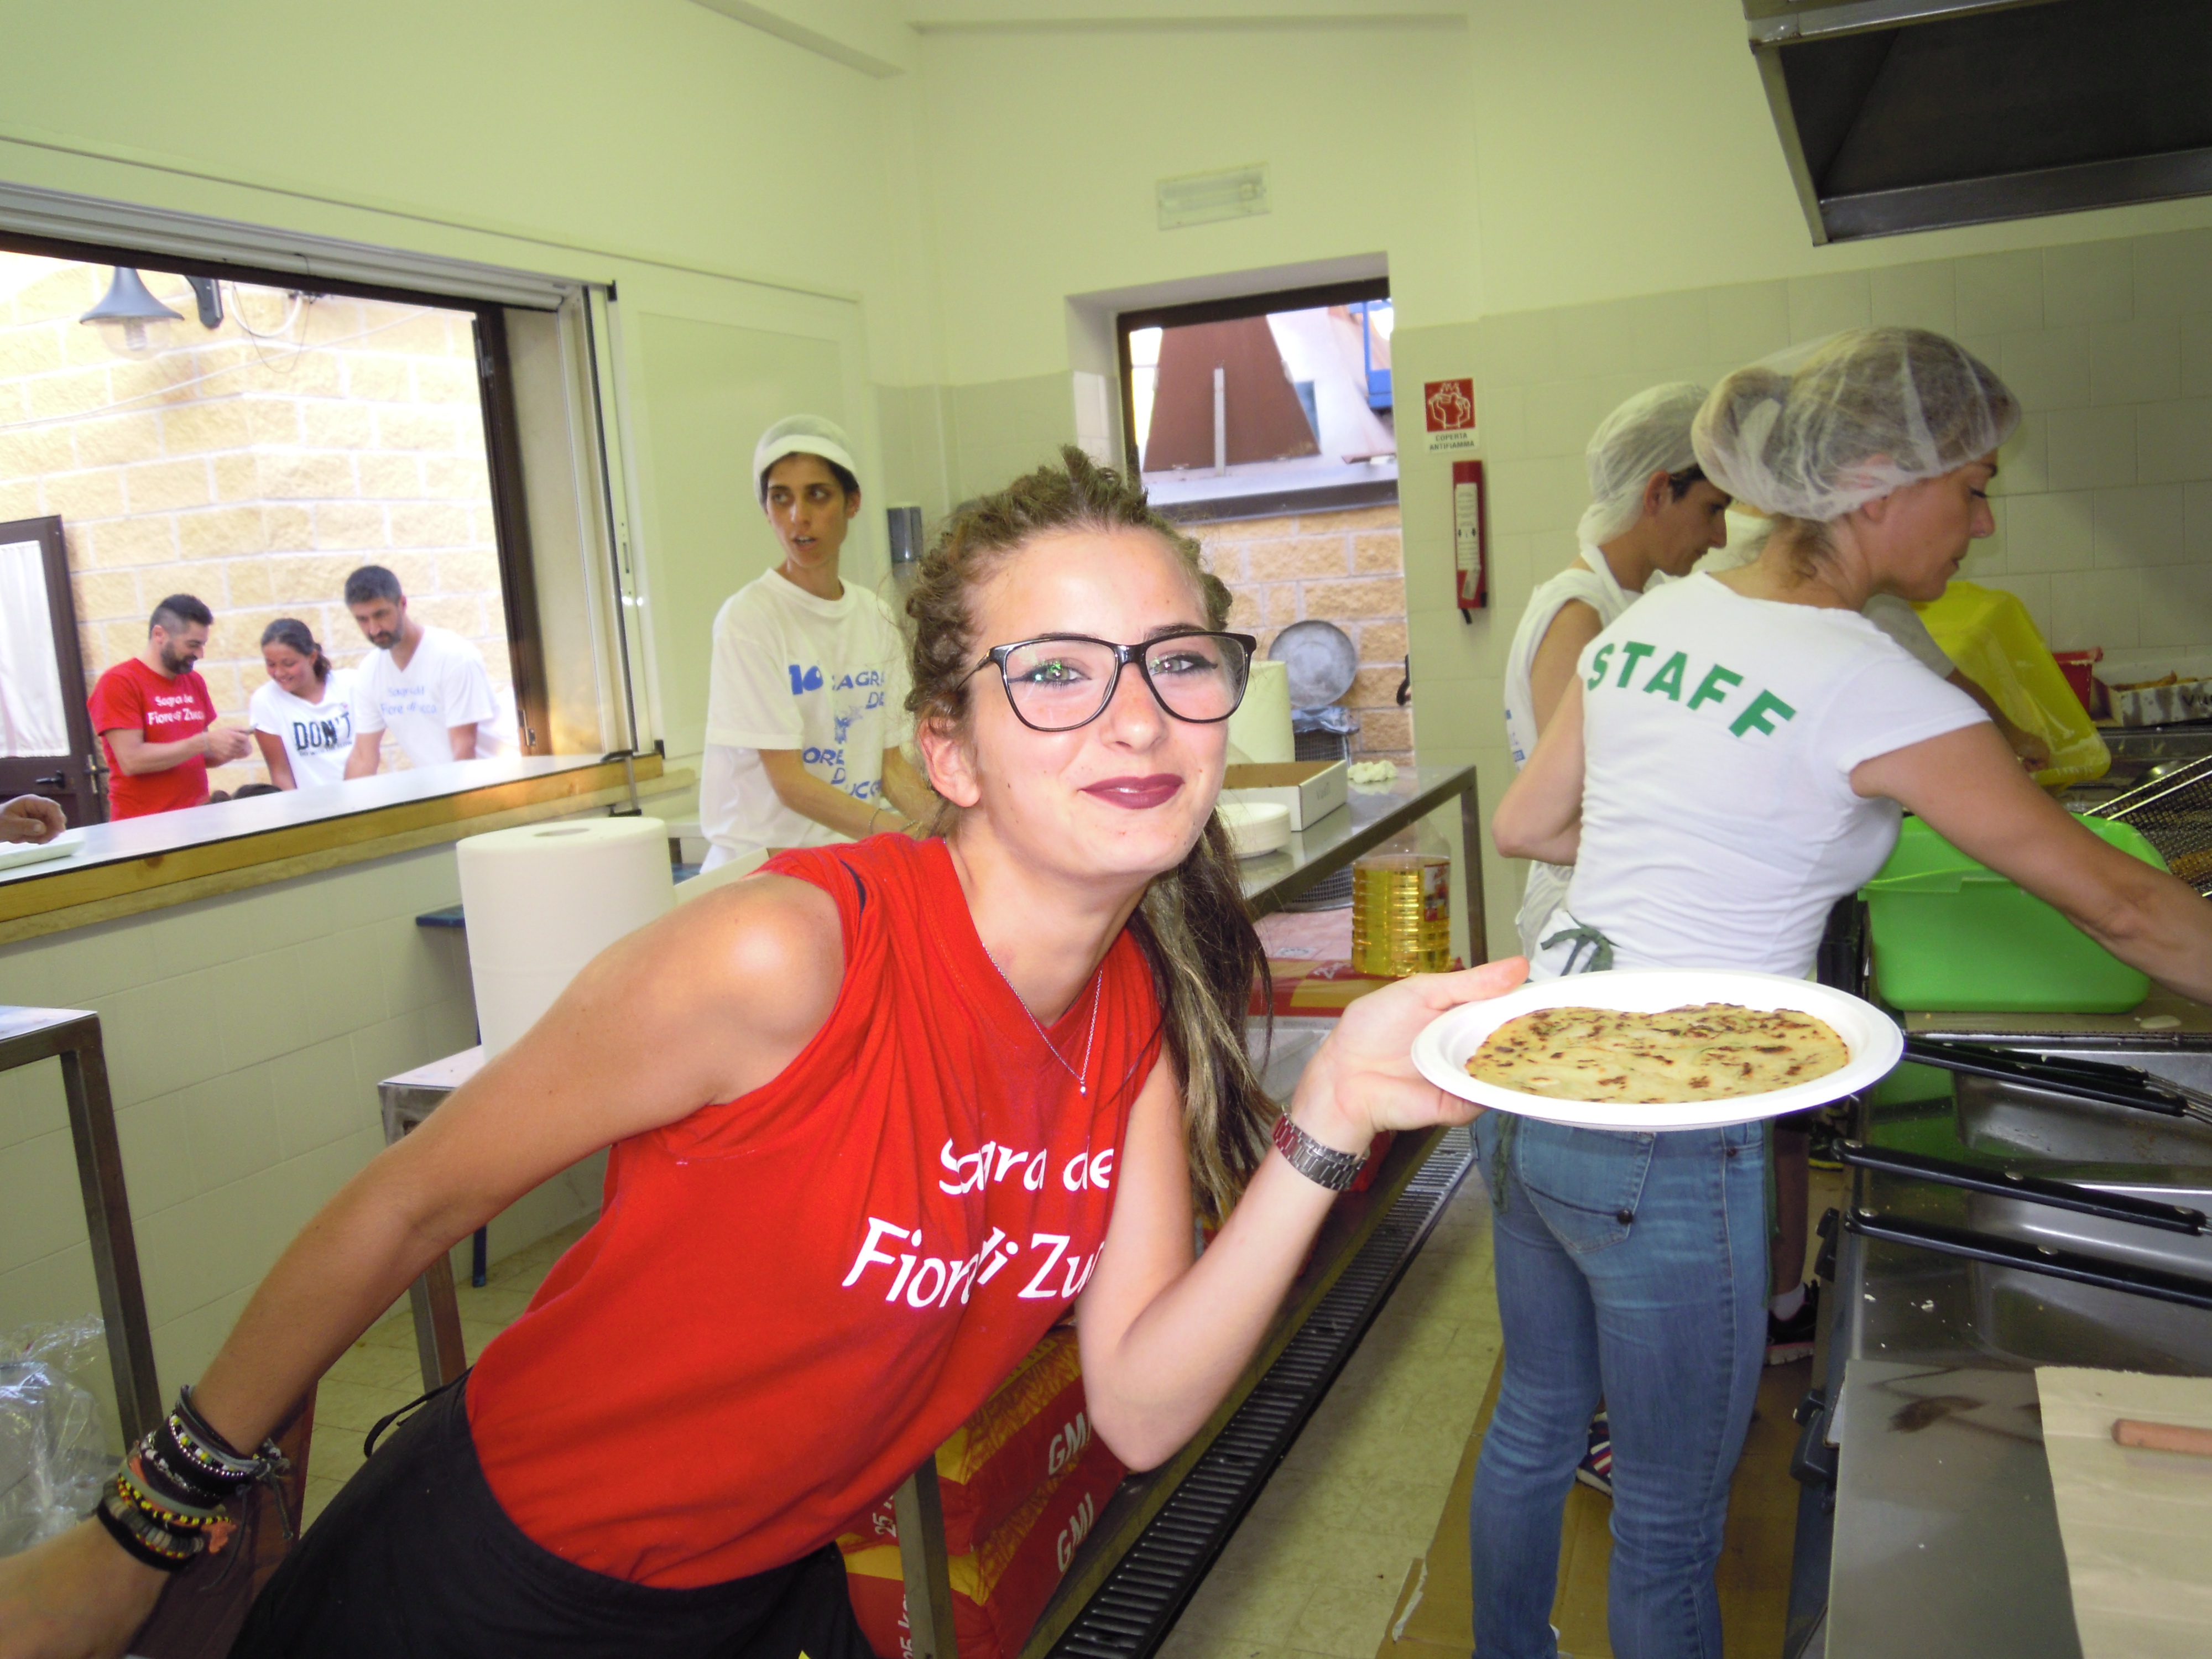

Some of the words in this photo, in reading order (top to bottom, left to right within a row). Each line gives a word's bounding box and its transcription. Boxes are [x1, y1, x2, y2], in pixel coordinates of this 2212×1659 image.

[1430, 441, 1475, 450] ANTIFIAMMA
[1436, 432, 1467, 442] COPERTA
[832, 671, 884, 691] AGR
[1587, 641, 1797, 738] STAFF
[293, 711, 351, 751] DON'T
[1017, 1233, 1105, 1298] Zu
[1057, 1492, 1094, 1573] GMI
